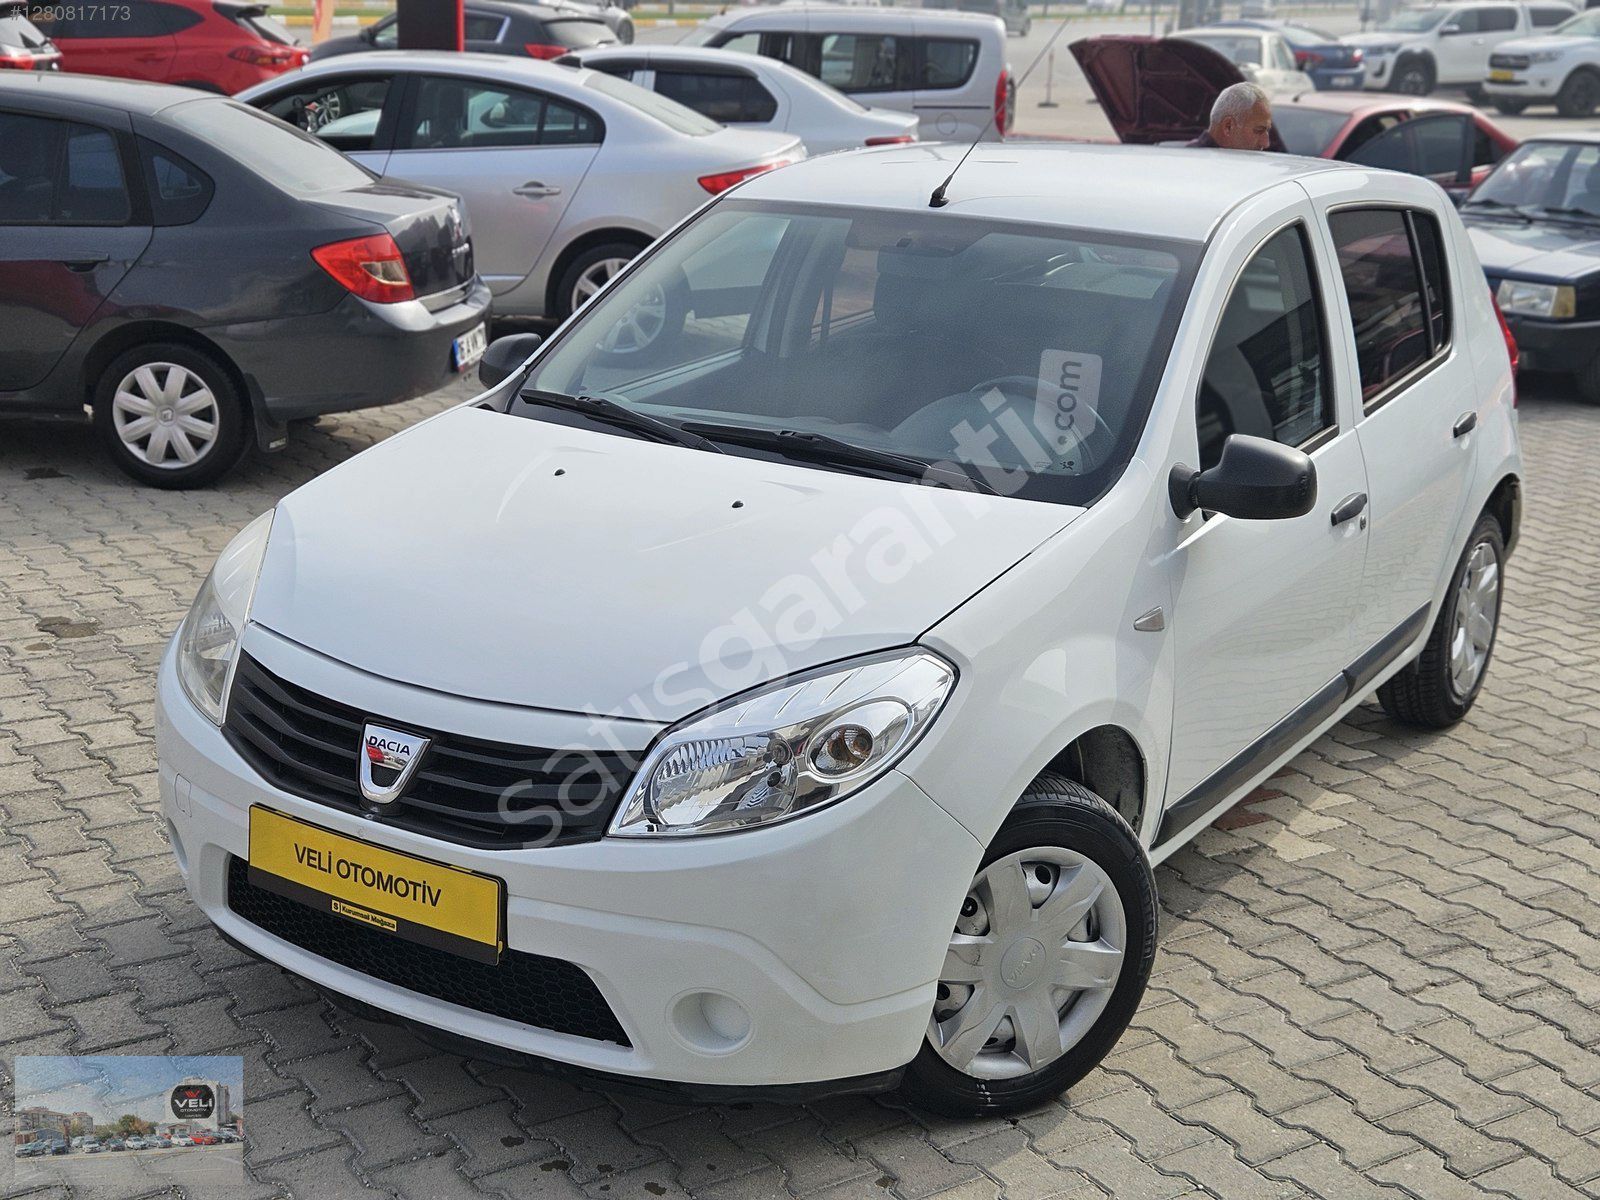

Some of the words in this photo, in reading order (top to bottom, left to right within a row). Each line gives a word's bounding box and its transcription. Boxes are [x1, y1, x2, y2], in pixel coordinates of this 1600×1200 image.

[368, 735, 410, 756] DACIA
[294, 843, 332, 874] VELİ
[336, 858, 442, 907] OTOMOTİV
[341, 904, 370, 921] Kurumsal
